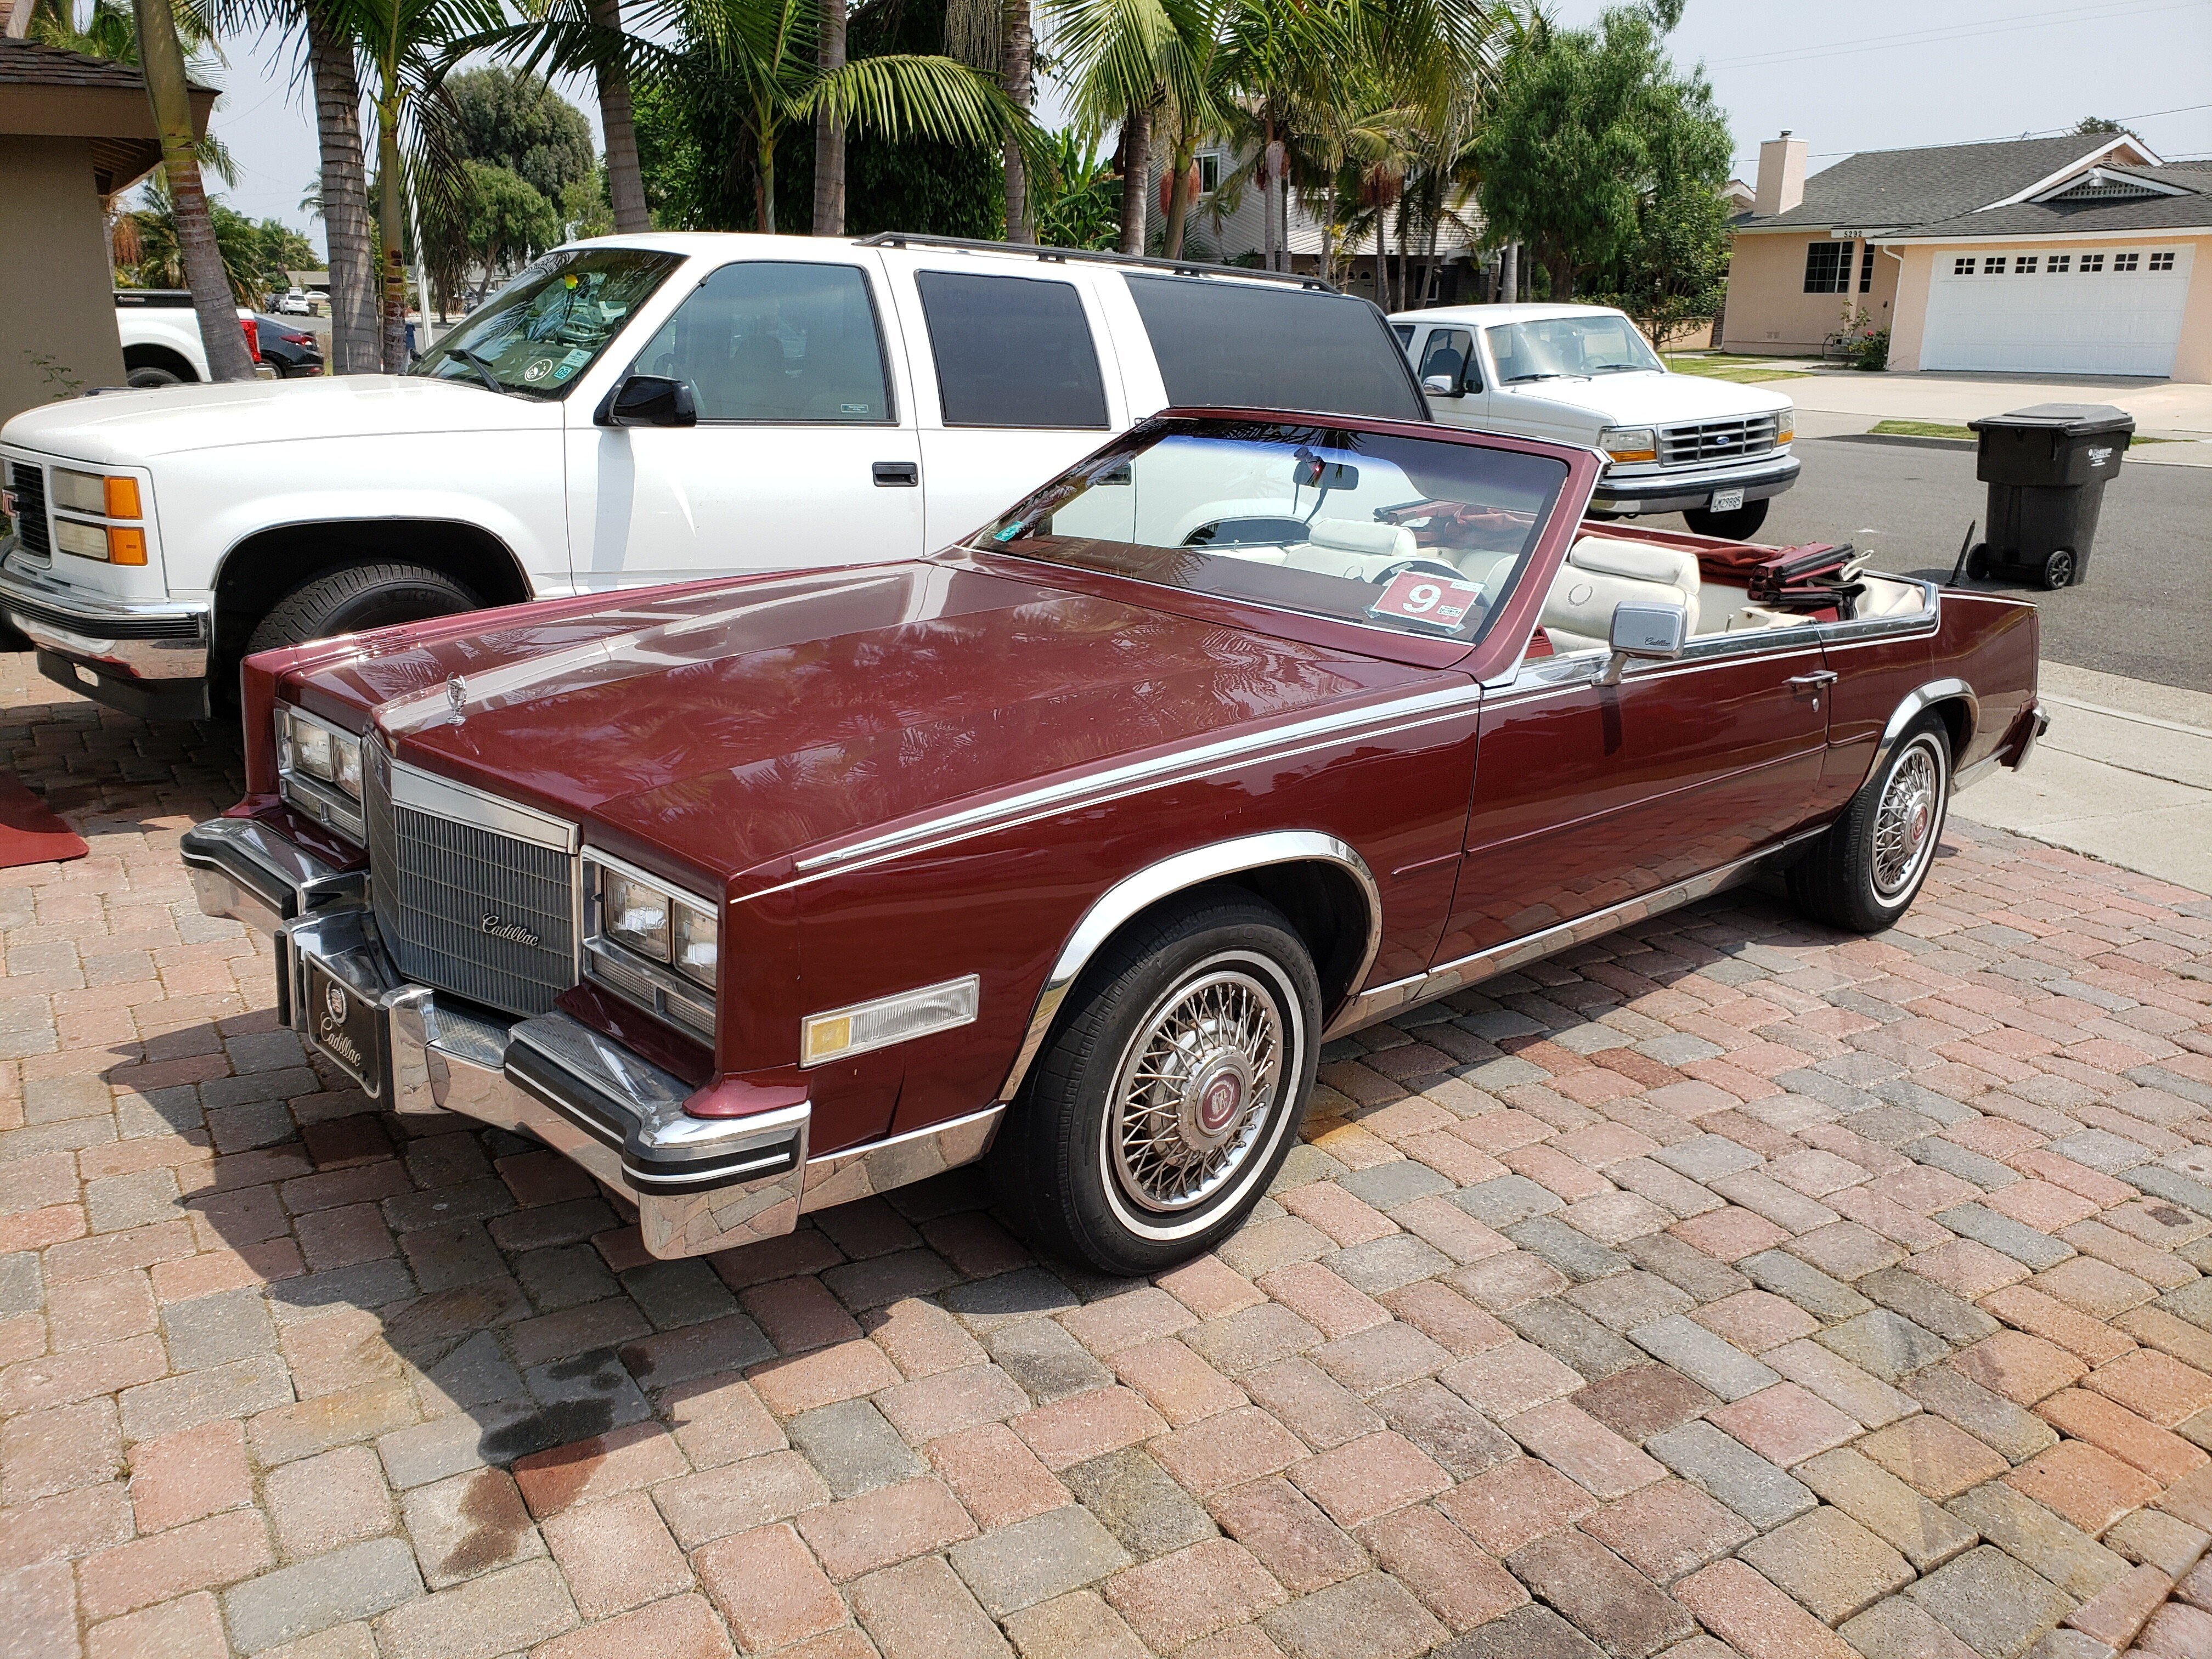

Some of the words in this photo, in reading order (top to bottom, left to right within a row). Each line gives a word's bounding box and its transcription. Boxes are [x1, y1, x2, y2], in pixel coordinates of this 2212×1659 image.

[1403, 584, 1441, 613] 9
[1644, 636, 1671, 646] Cadillac
[482, 913, 539, 946] Cadillac
[320, 1011, 361, 1067] Cadillac
